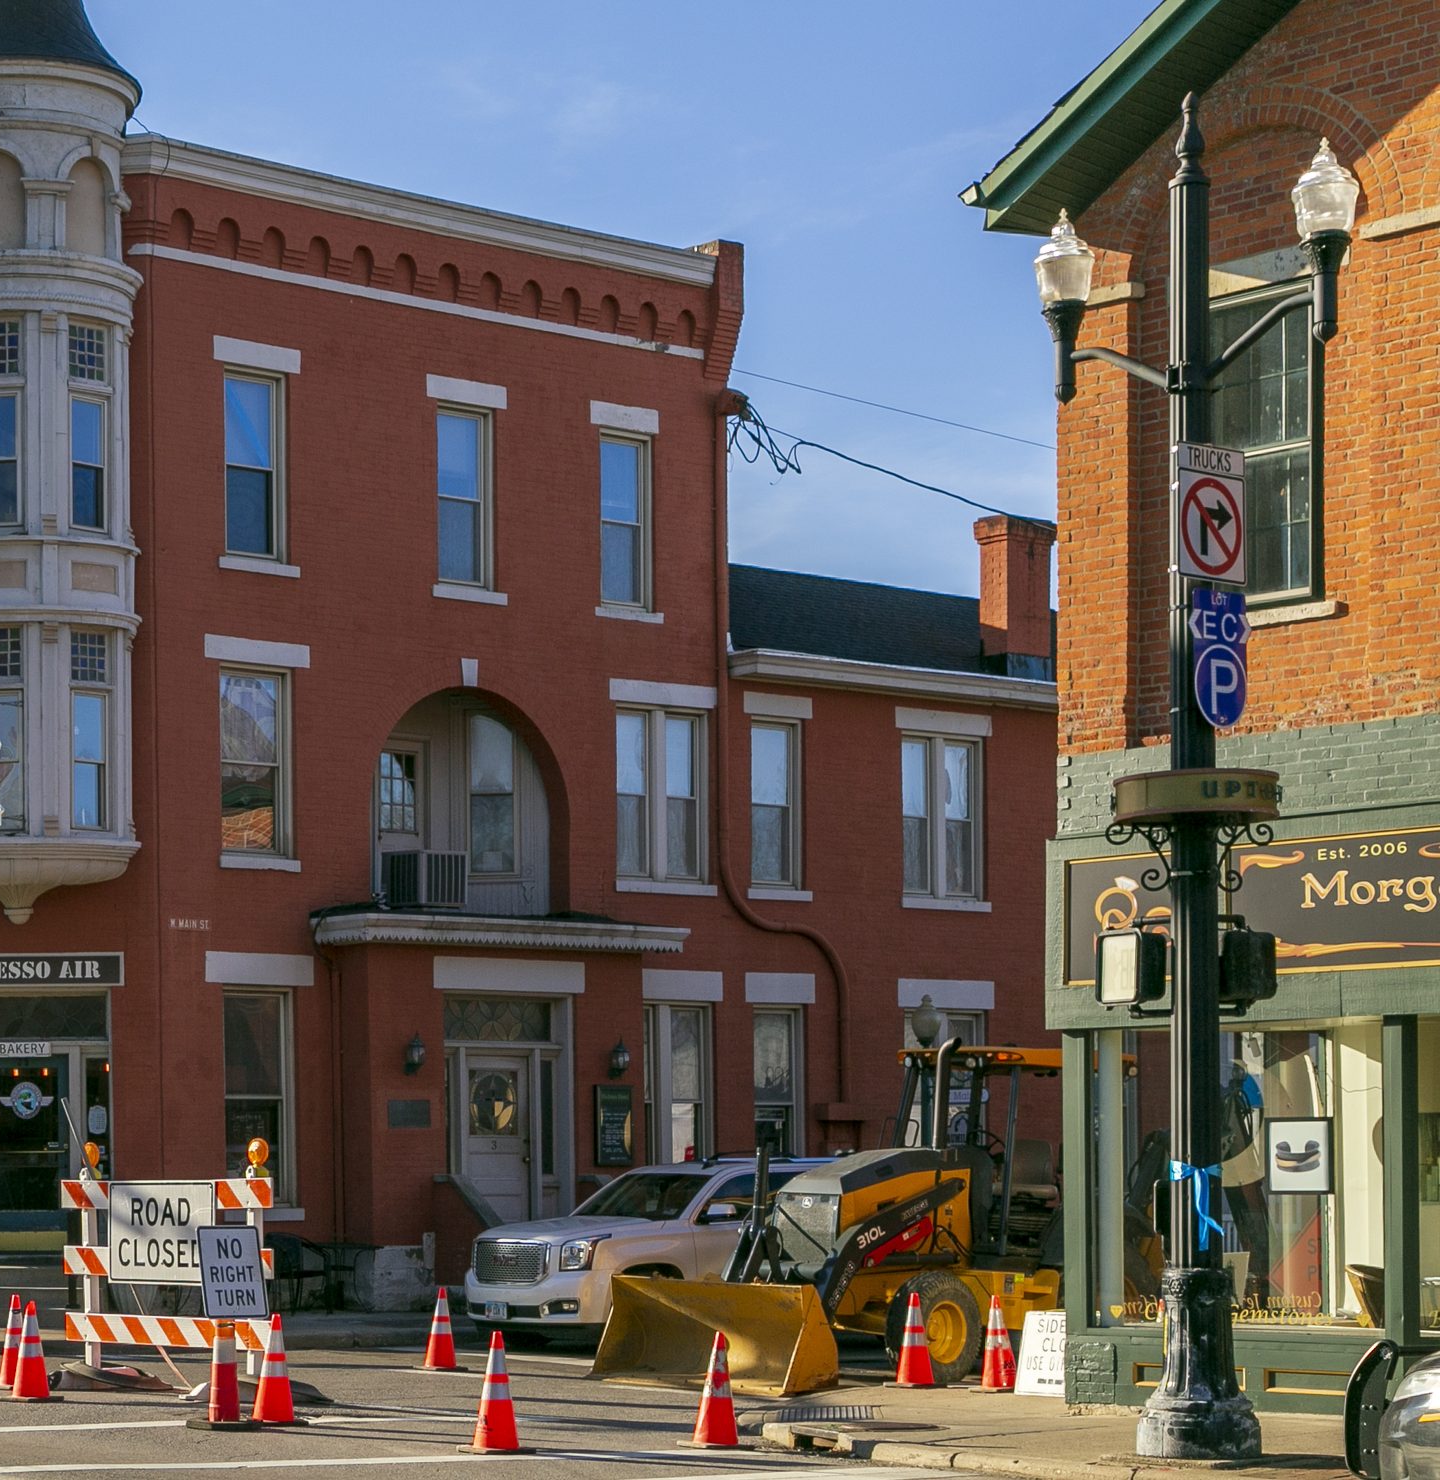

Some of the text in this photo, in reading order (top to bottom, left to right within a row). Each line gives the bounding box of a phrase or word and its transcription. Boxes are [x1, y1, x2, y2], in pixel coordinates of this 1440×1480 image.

[1188, 446, 1231, 473] TRUCKS
[1211, 592, 1228, 606] LOT
[1211, 658, 1238, 714] P
[1317, 841, 1408, 861] Est. 2006
[1301, 870, 1440, 913] Morg
[179, 918, 197, 928] MAIN
[59, 960, 101, 979] AIR
[0, 1043, 46, 1054] BAKERY
[131, 1198, 190, 1226] ROAD
[857, 1226, 886, 1249] 310L
[216, 1238, 242, 1259] NO
[211, 1266, 254, 1282] RIGHT
[215, 1289, 257, 1306] TURN
